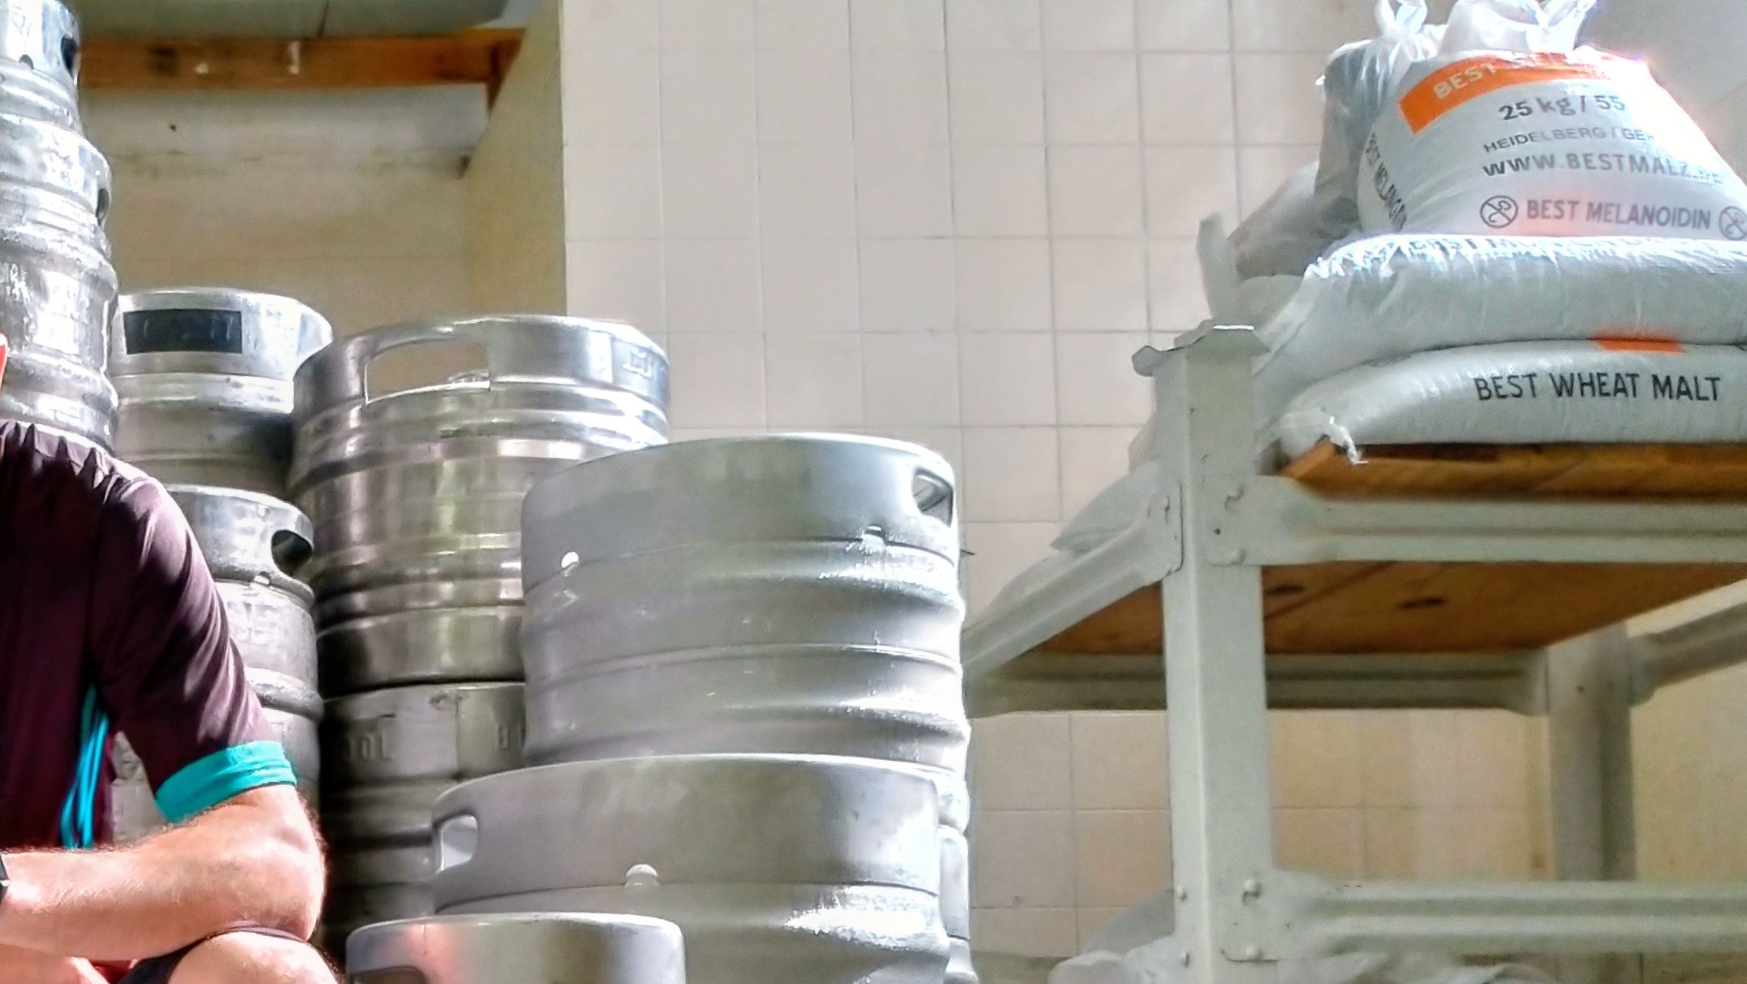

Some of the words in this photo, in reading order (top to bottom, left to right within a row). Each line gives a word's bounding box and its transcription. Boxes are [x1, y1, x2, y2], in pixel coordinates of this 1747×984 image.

[1433, 61, 1498, 99] BEST
[1498, 100, 1533, 120] 25
[1539, 97, 1575, 116] kg
[1598, 95, 1626, 111] 55
[1483, 127, 1607, 153] HEIDELBERG
[1526, 199, 1580, 221] BEST
[1586, 203, 1711, 230] MELANOIDIN
[1474, 373, 1538, 401] BEST
[1549, 371, 1640, 399] WHEAT
[1651, 373, 1721, 401] MALT
